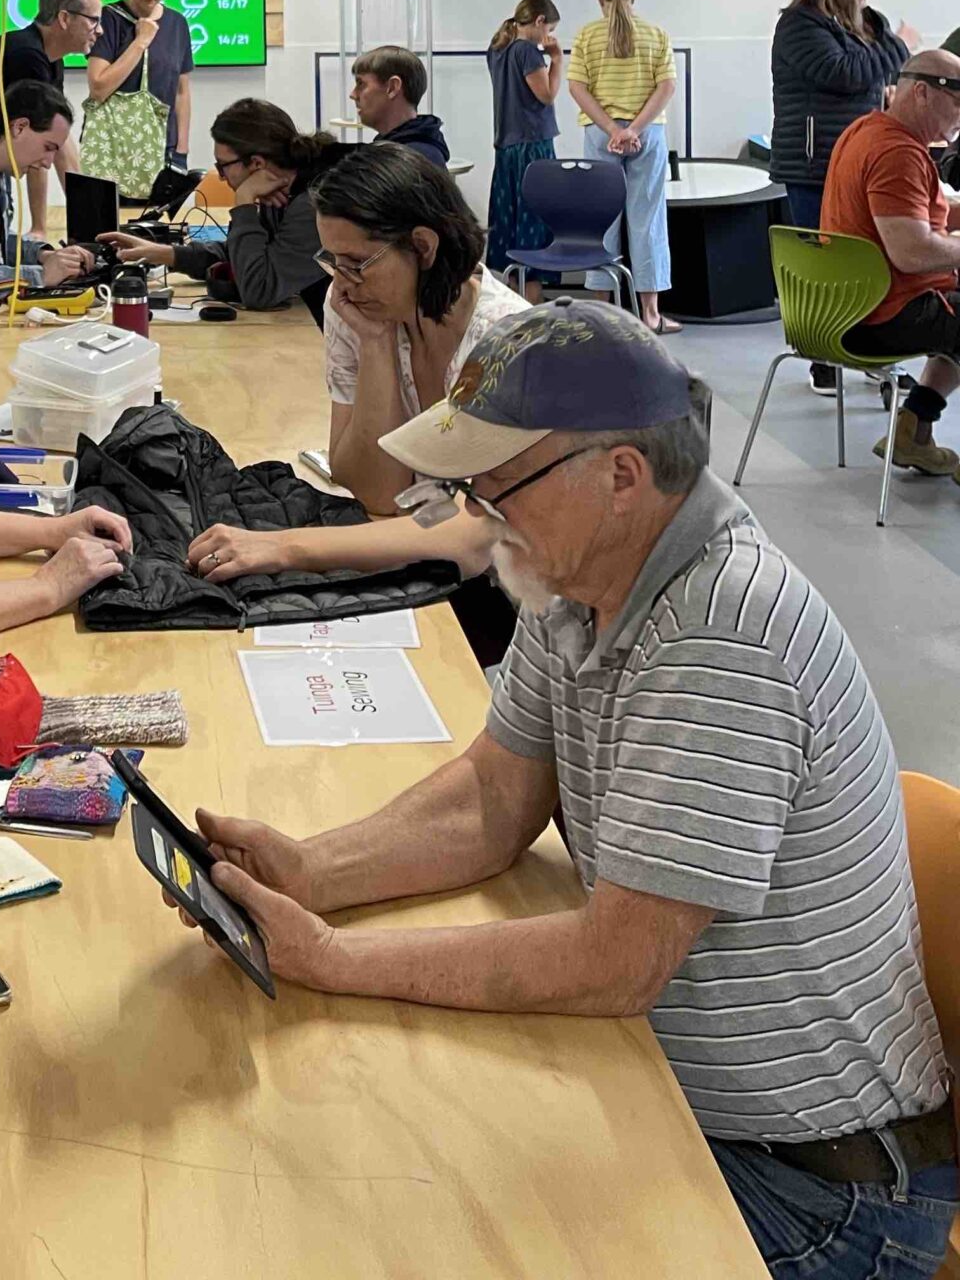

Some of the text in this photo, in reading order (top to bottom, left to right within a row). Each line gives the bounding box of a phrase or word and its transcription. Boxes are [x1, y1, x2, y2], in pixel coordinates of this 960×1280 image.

[218, 34, 249, 45] 14/21
[309, 621, 333, 640] Tap
[342, 670, 377, 713] Sewing
